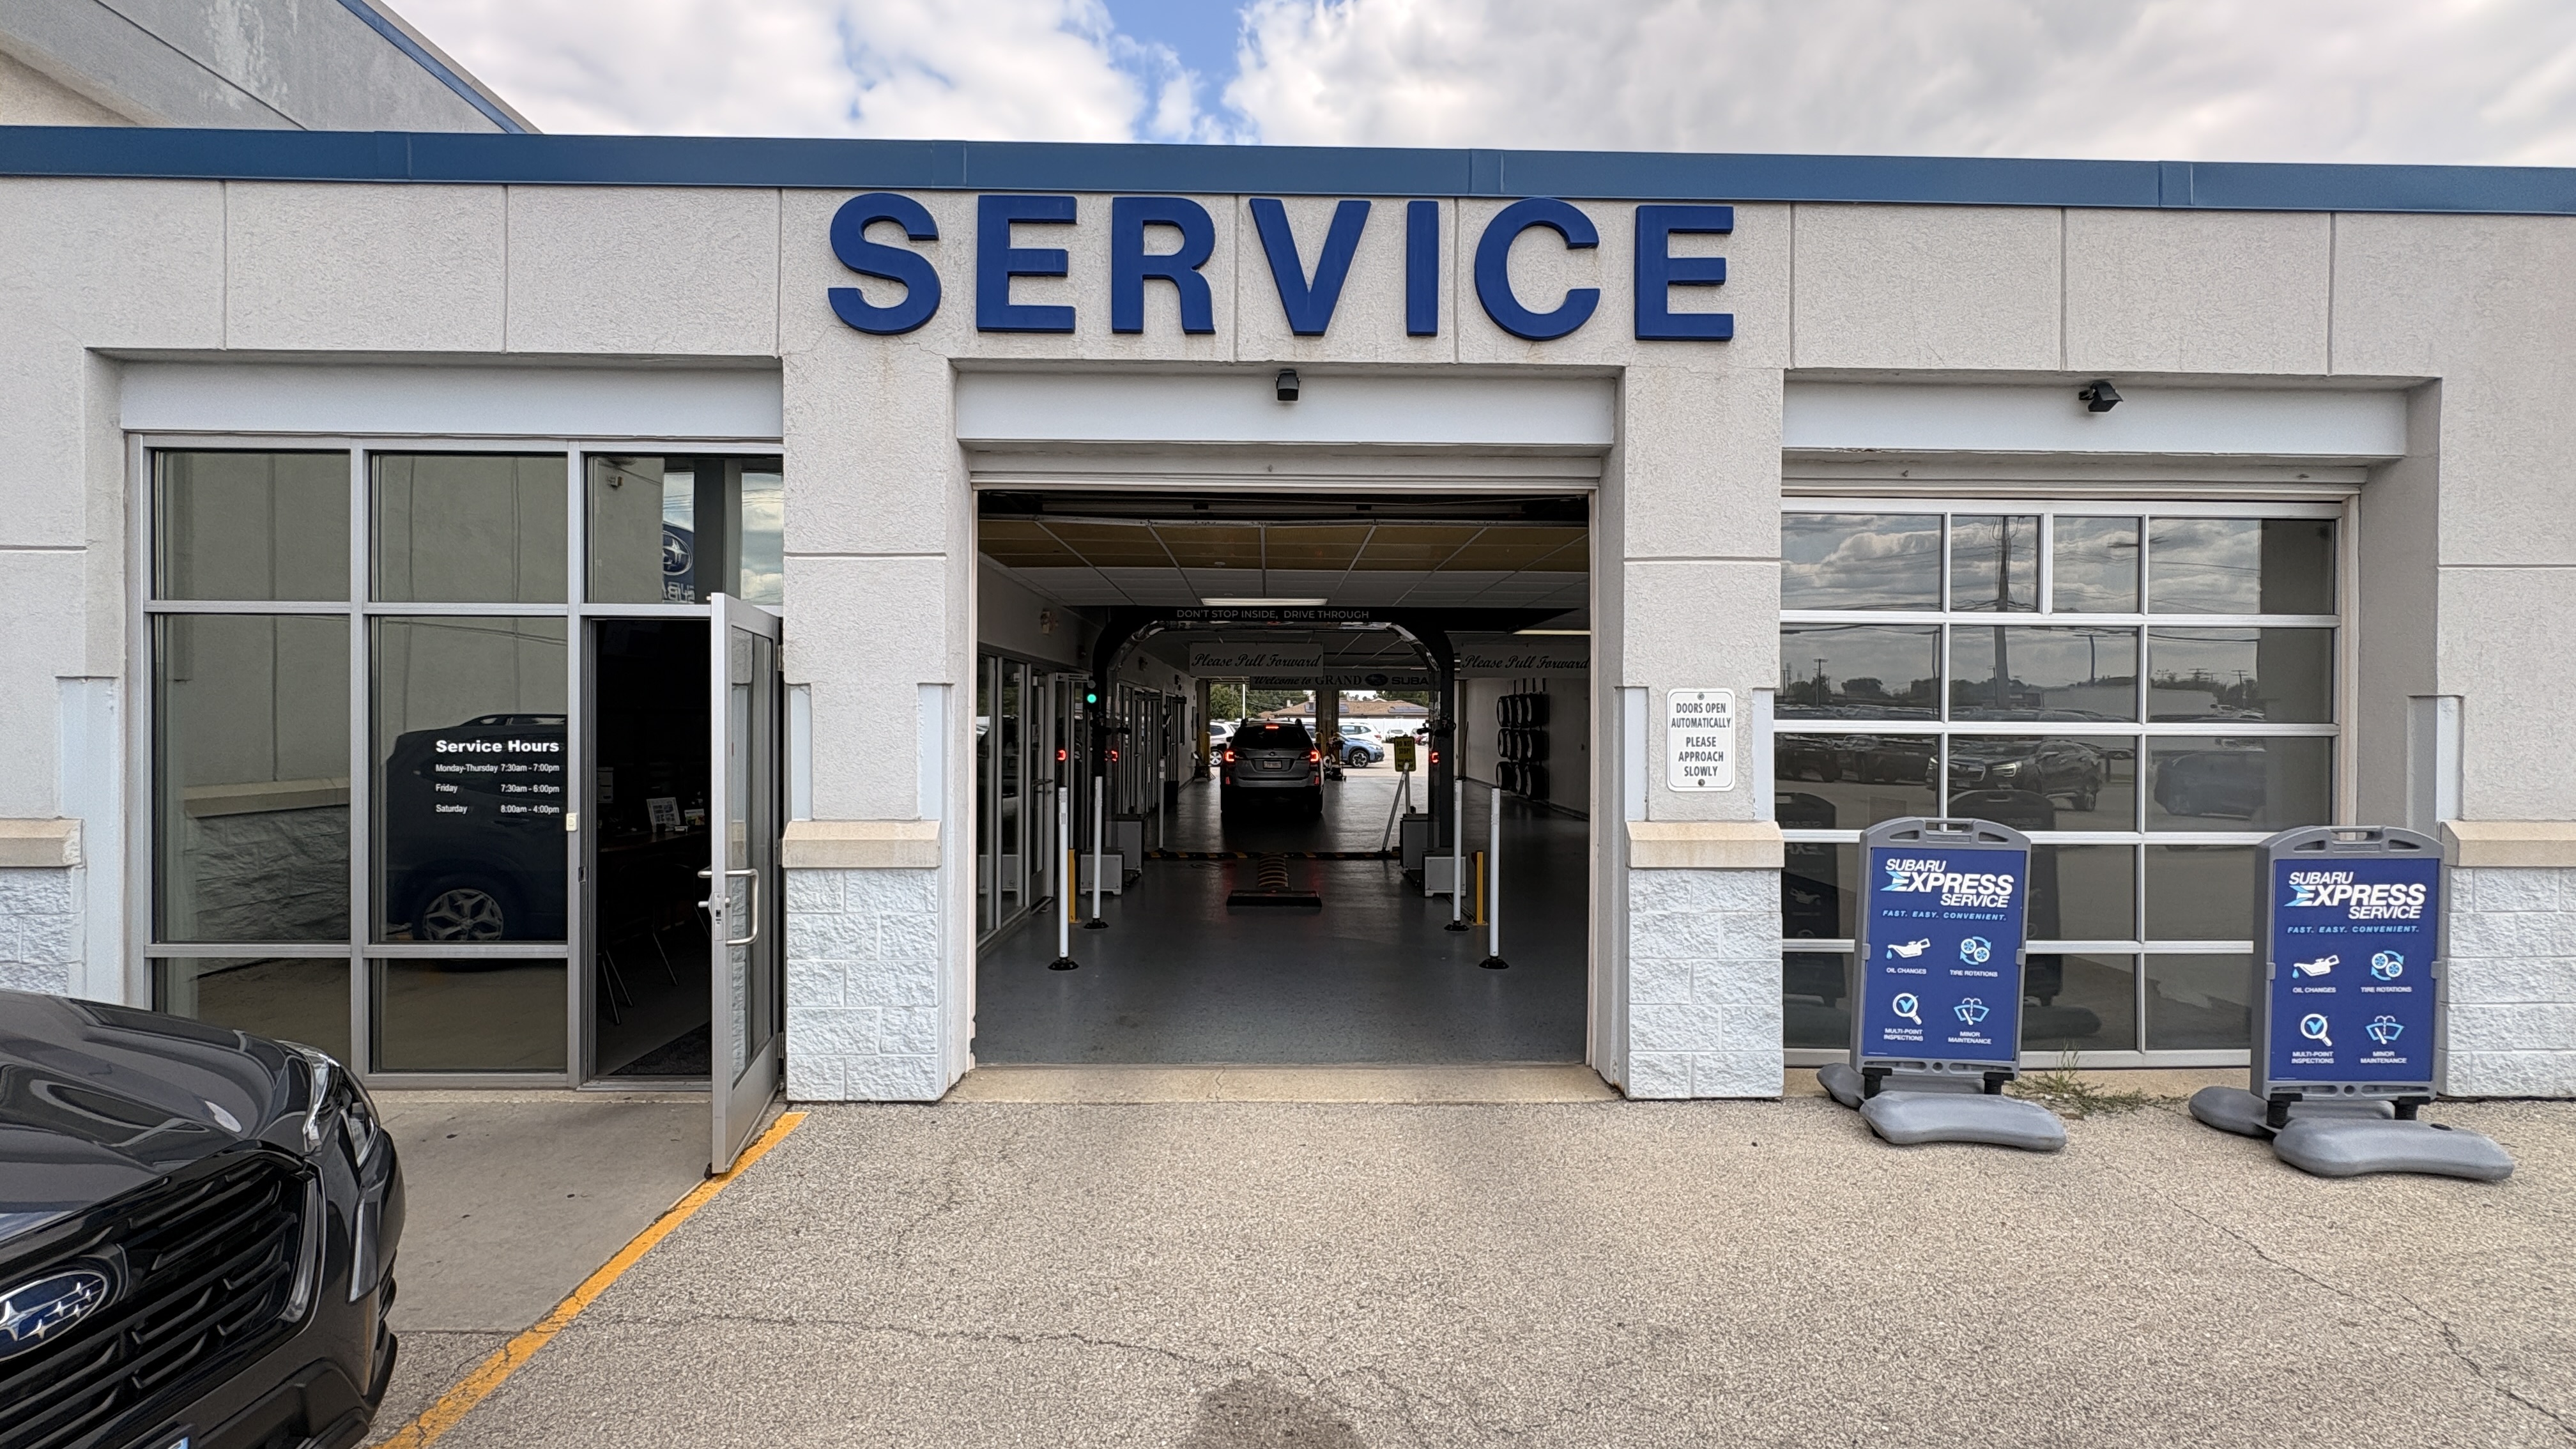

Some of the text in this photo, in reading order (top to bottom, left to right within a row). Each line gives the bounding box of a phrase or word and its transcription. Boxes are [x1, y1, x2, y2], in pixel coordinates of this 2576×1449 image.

[827, 192, 1735, 342] SERVICE
[1177, 610, 1210, 618] DON'T
[1211, 610, 1238, 618] STOP
[1241, 610, 1278, 619] INSIDE,
[1192, 654, 1322, 667] Please Pull Forward
[1462, 655, 1590, 669] Please Pull Forward
[1315, 675, 1361, 686] GRAND
[1676, 703, 1726, 714] DOORS OPEN
[1671, 717, 1731, 728] AUTOMATICALLY
[436, 739, 559, 753] Service Hours
[1686, 737, 1717, 747] PLEASE
[1678, 751, 1724, 762] APPROACH
[436, 763, 498, 774] Monday-Thursday
[501, 763, 527, 772] 7:30am
[533, 763, 560, 773] 7:00pm
[1684, 766, 1718, 776] SLOWLY
[436, 784, 458, 793] Friday
[533, 785, 560, 794] 6:00pm
[436, 804, 468, 814] Saturday
[501, 805, 527, 813] 8:00am
[533, 805, 560, 815] 4:00pm
[1885, 859, 1947, 872] SUBARU
[1880, 871, 2014, 895] EXPRESS
[2288, 871, 2354, 885] SUBARU
[1940, 894, 2010, 908] SERVICE
[2284, 884, 2426, 907] EXPRESS
[1943, 912, 2007, 921] CONVENIENT.
[2348, 906, 2423, 920] SERVICE
[2352, 925, 2419, 933] CONVENIENT.
